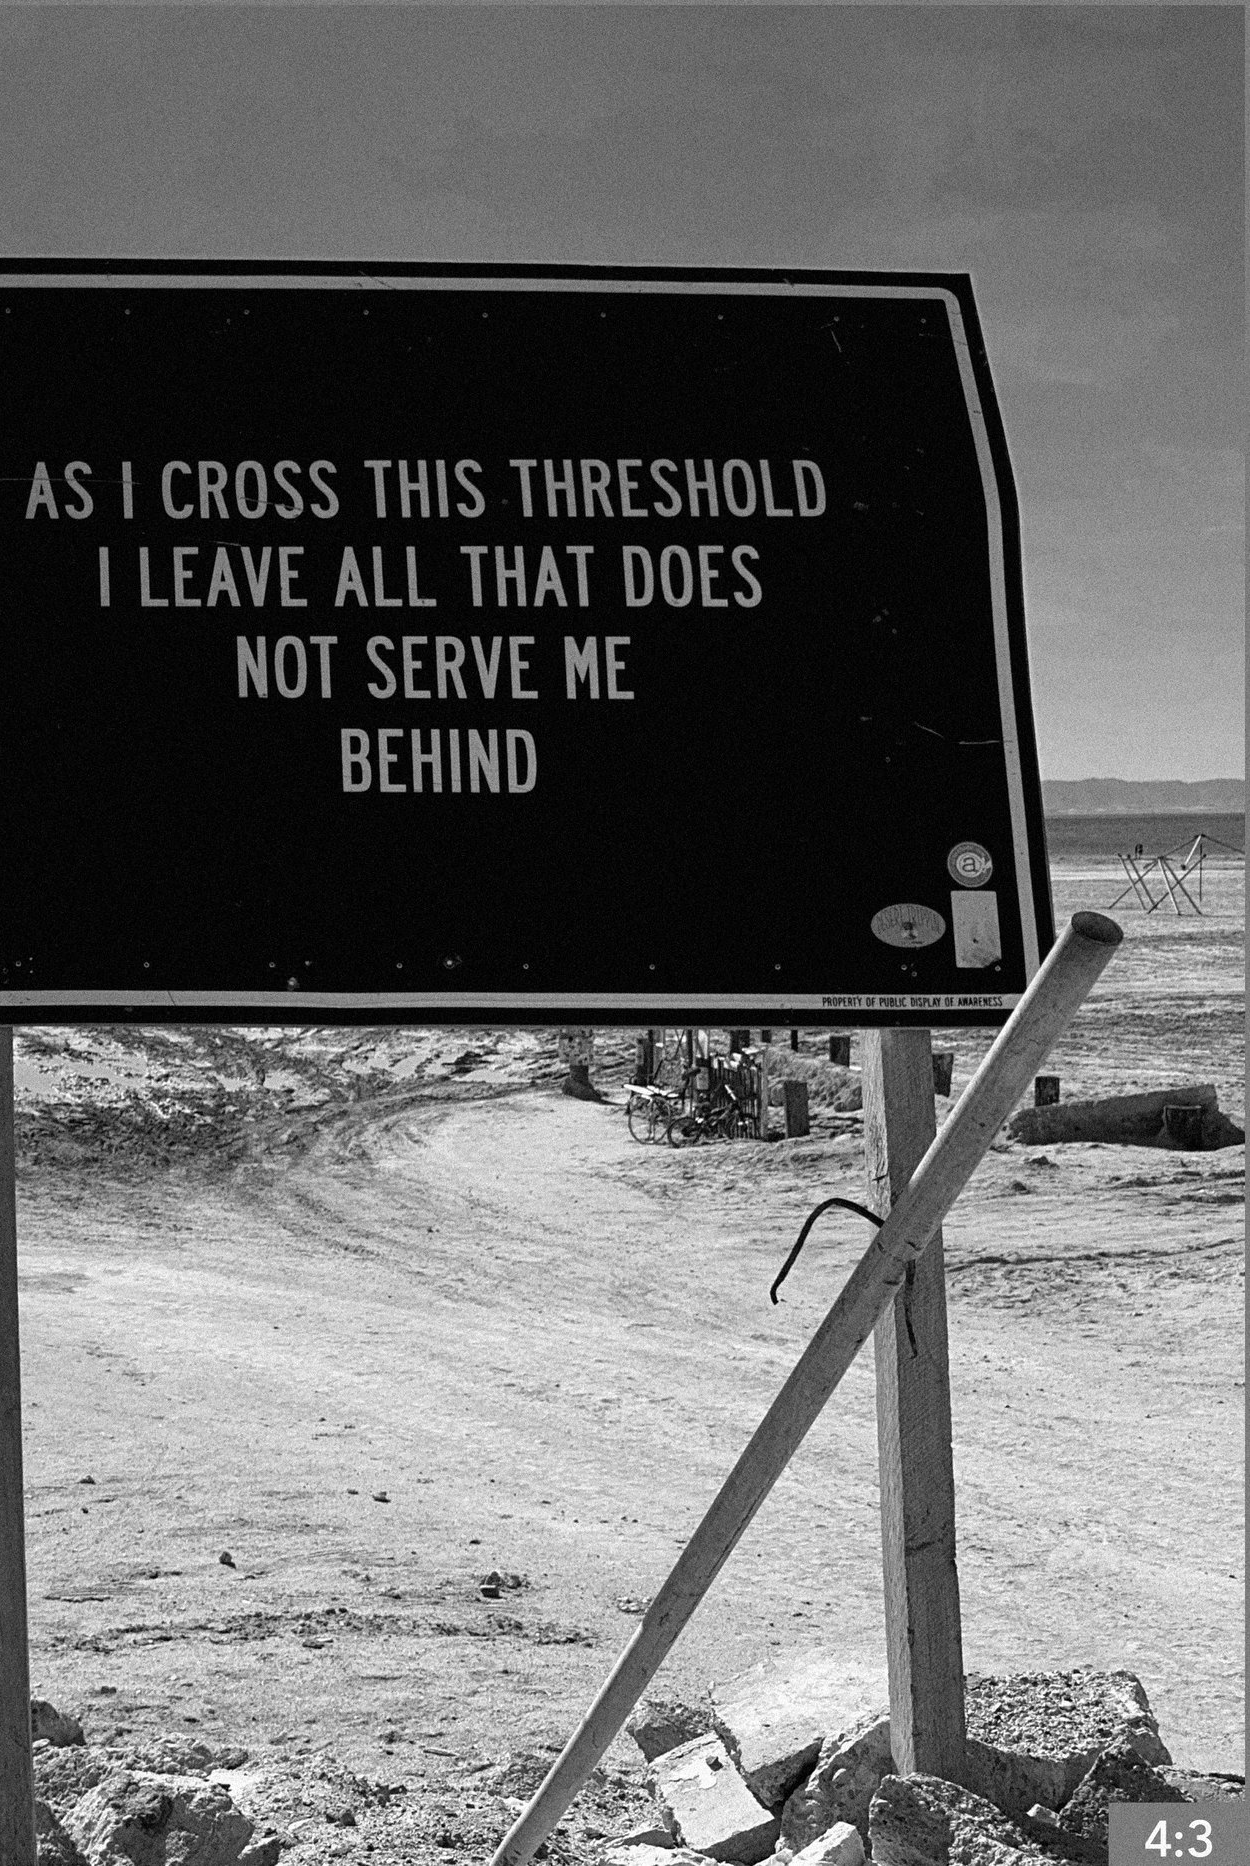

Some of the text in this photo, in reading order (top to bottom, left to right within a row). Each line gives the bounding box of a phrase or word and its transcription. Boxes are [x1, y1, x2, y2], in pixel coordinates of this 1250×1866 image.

[26, 458, 826, 520] AS I CROSS THIS THRESHOLD
[99, 545, 763, 608] I LEAVE ALL THAT DOES
[236, 635, 635, 700] NOT SERVE ME
[341, 728, 537, 793] BEHIND
[822, 996, 1003, 1008] PROPERTY OF PUBLIC DISPLAY OF AWARENESS
